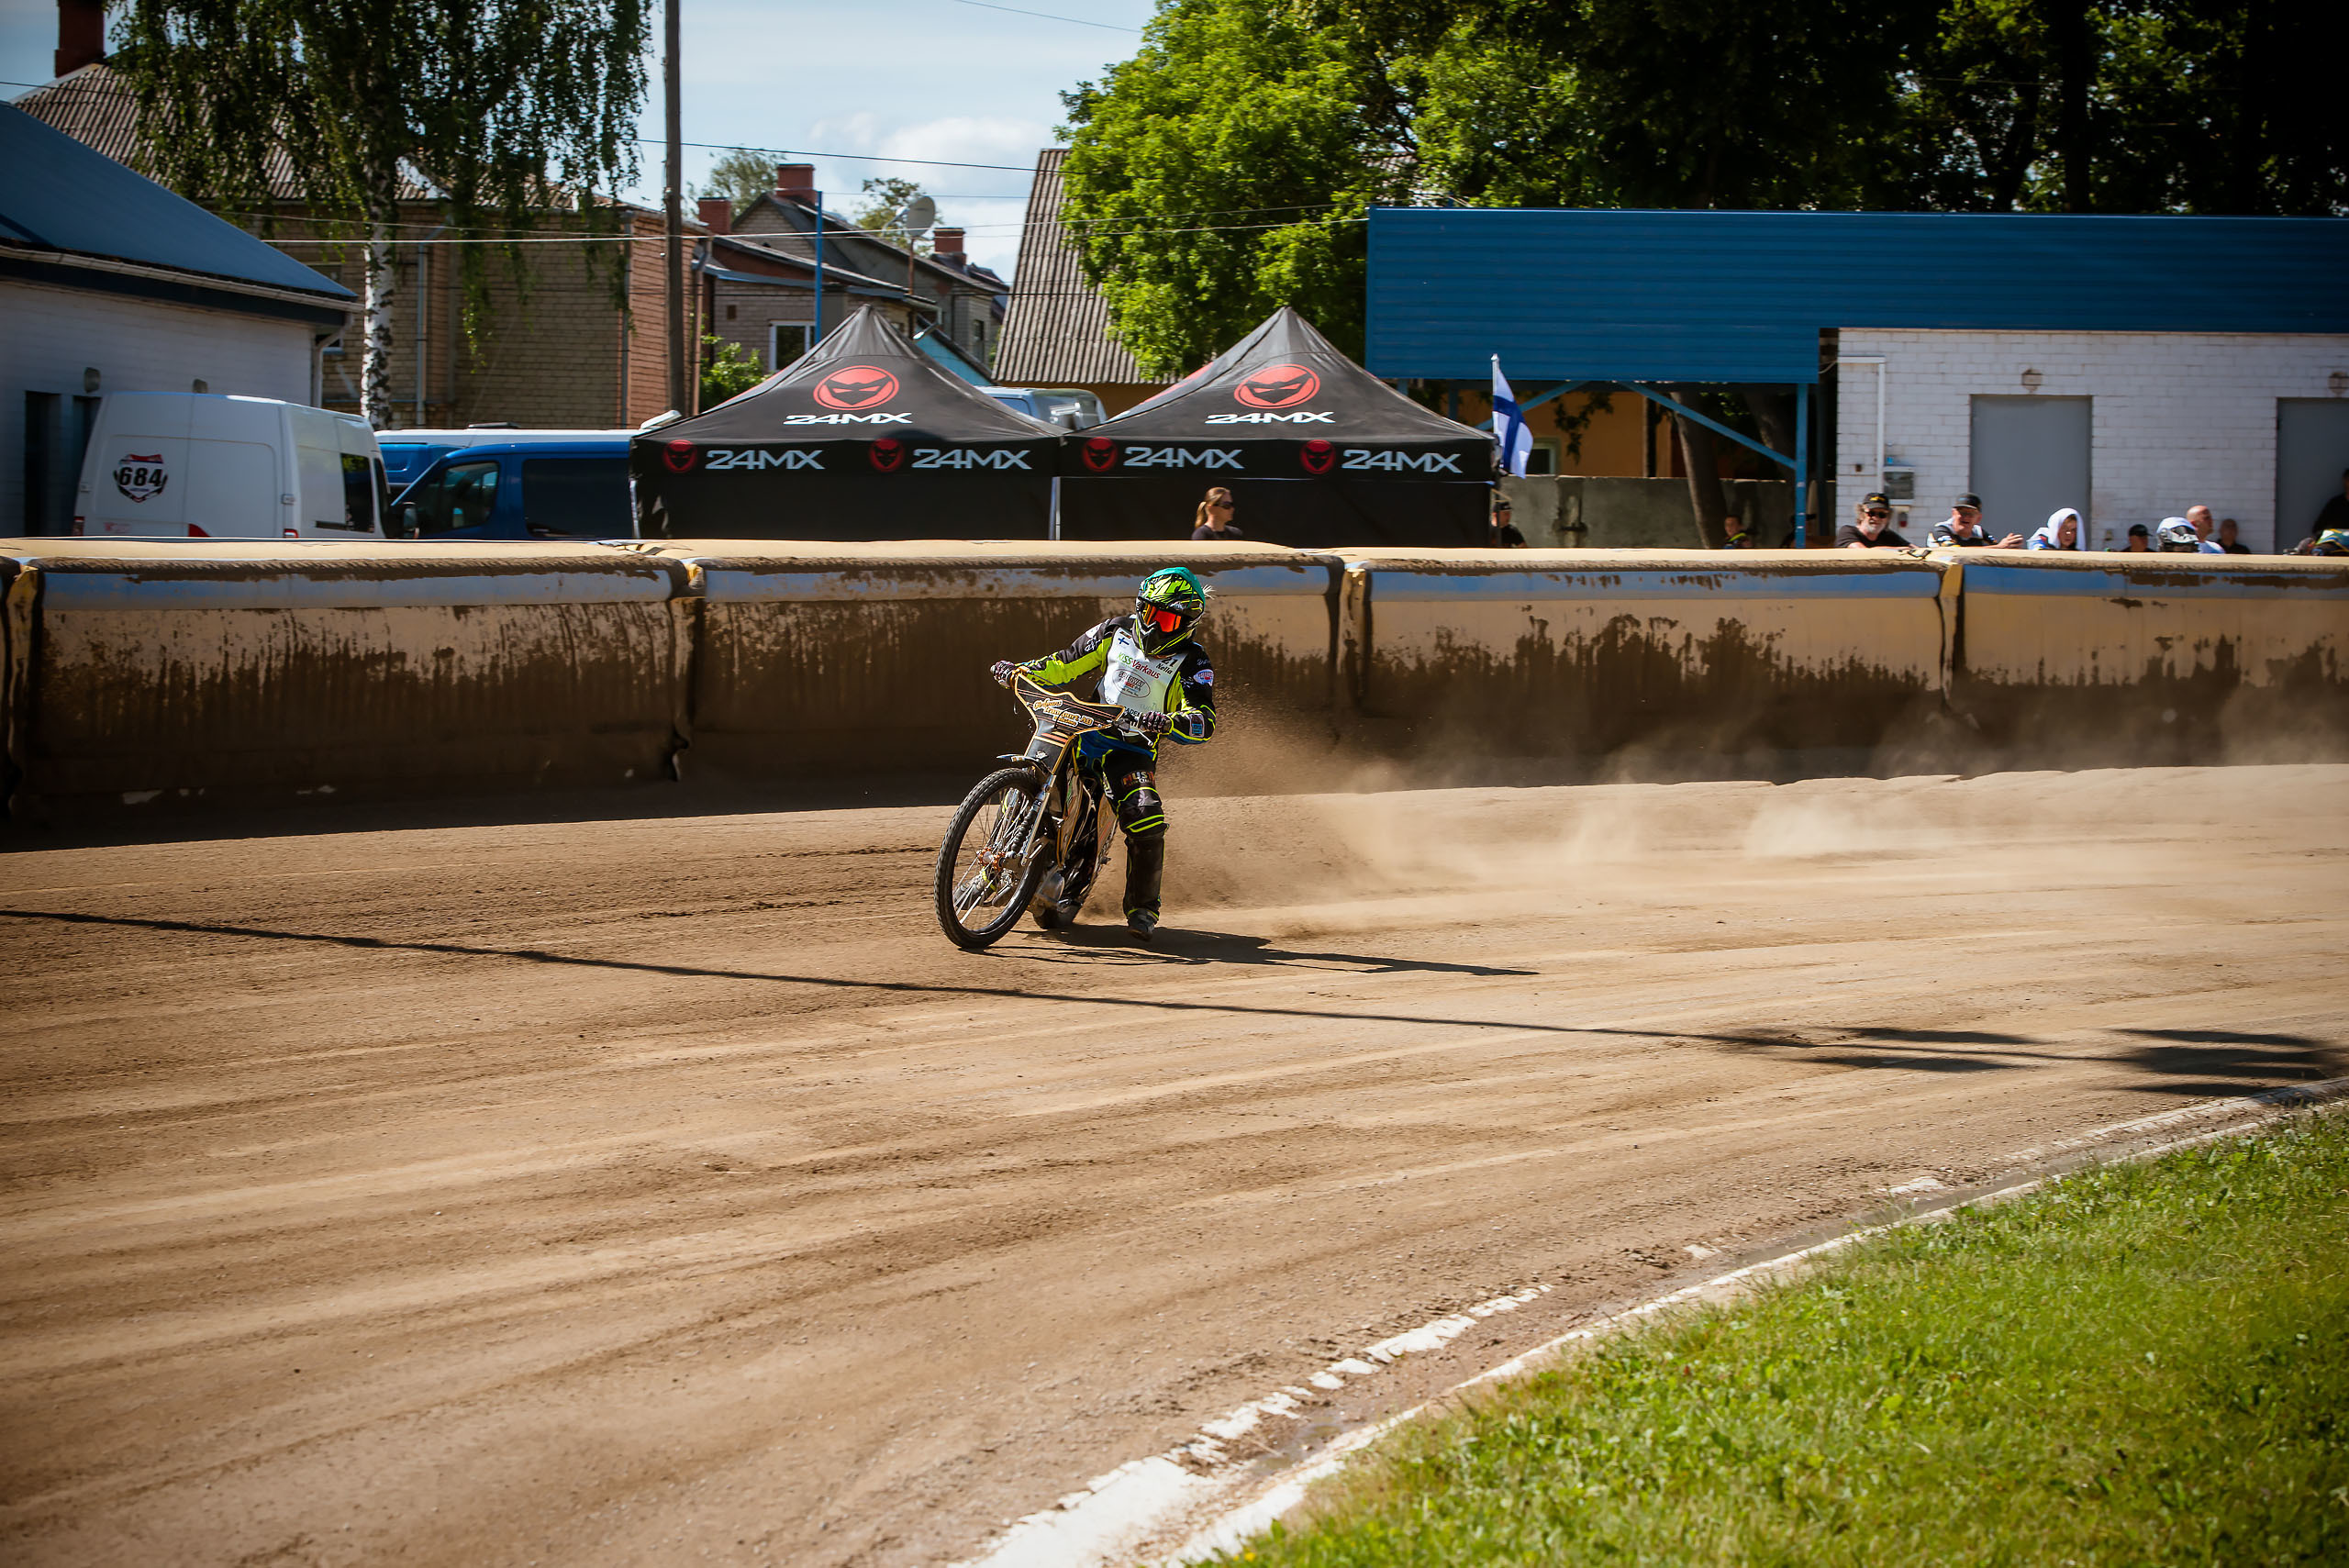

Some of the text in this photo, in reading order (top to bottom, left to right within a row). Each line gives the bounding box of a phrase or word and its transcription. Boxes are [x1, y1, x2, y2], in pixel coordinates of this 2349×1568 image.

[783, 412, 913, 425] 24MX
[1205, 411, 1336, 424] 24MX
[705, 449, 826, 470] 24MX
[911, 449, 1032, 470] 24MX
[1123, 446, 1245, 470] 24MX
[1341, 449, 1464, 473] 24MX
[119, 466, 163, 487] 684
[1162, 657, 1178, 668] 21
